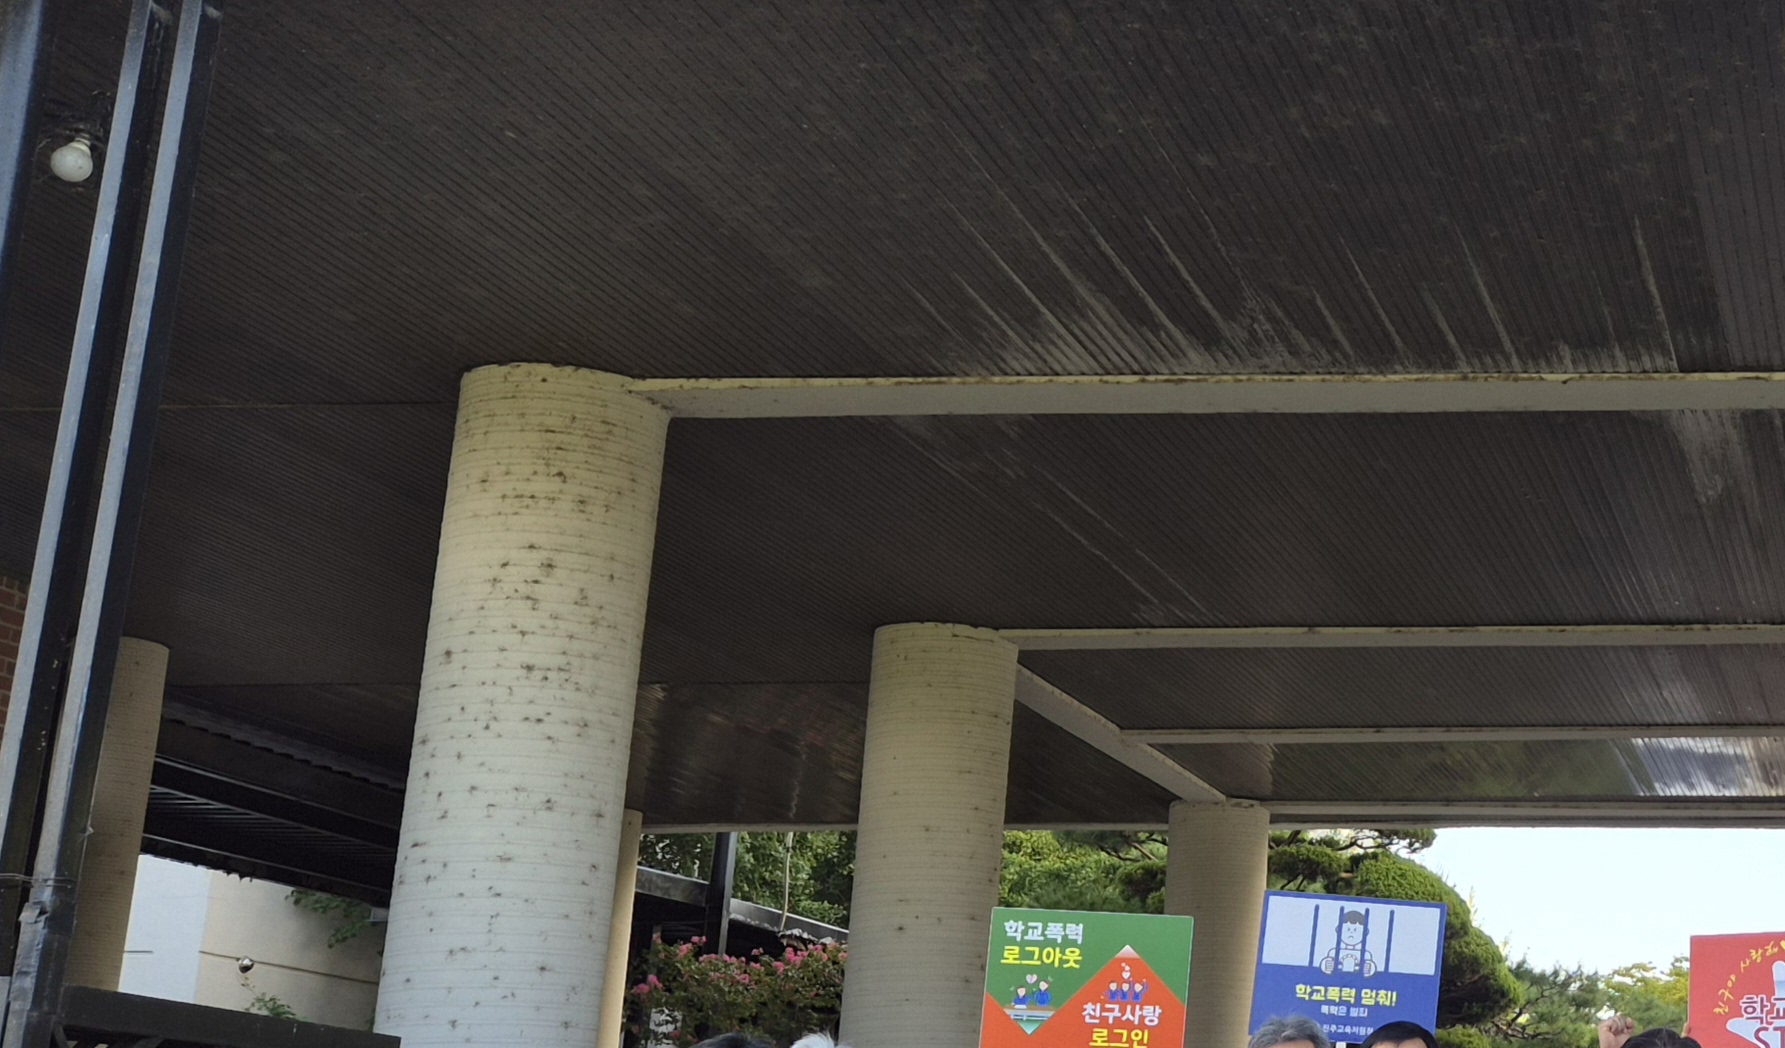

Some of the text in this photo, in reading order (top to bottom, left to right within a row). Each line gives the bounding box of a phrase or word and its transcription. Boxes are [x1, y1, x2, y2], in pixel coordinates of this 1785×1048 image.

[1004, 920, 1084, 944] 학교폭력
[1000, 945, 1083, 969] 로그아웃
[1740, 940, 1779, 973] 사랑해
[1295, 983, 1398, 1007] 학교폭력 멈춰!
[1082, 1002, 1162, 1026] 친구사랑
